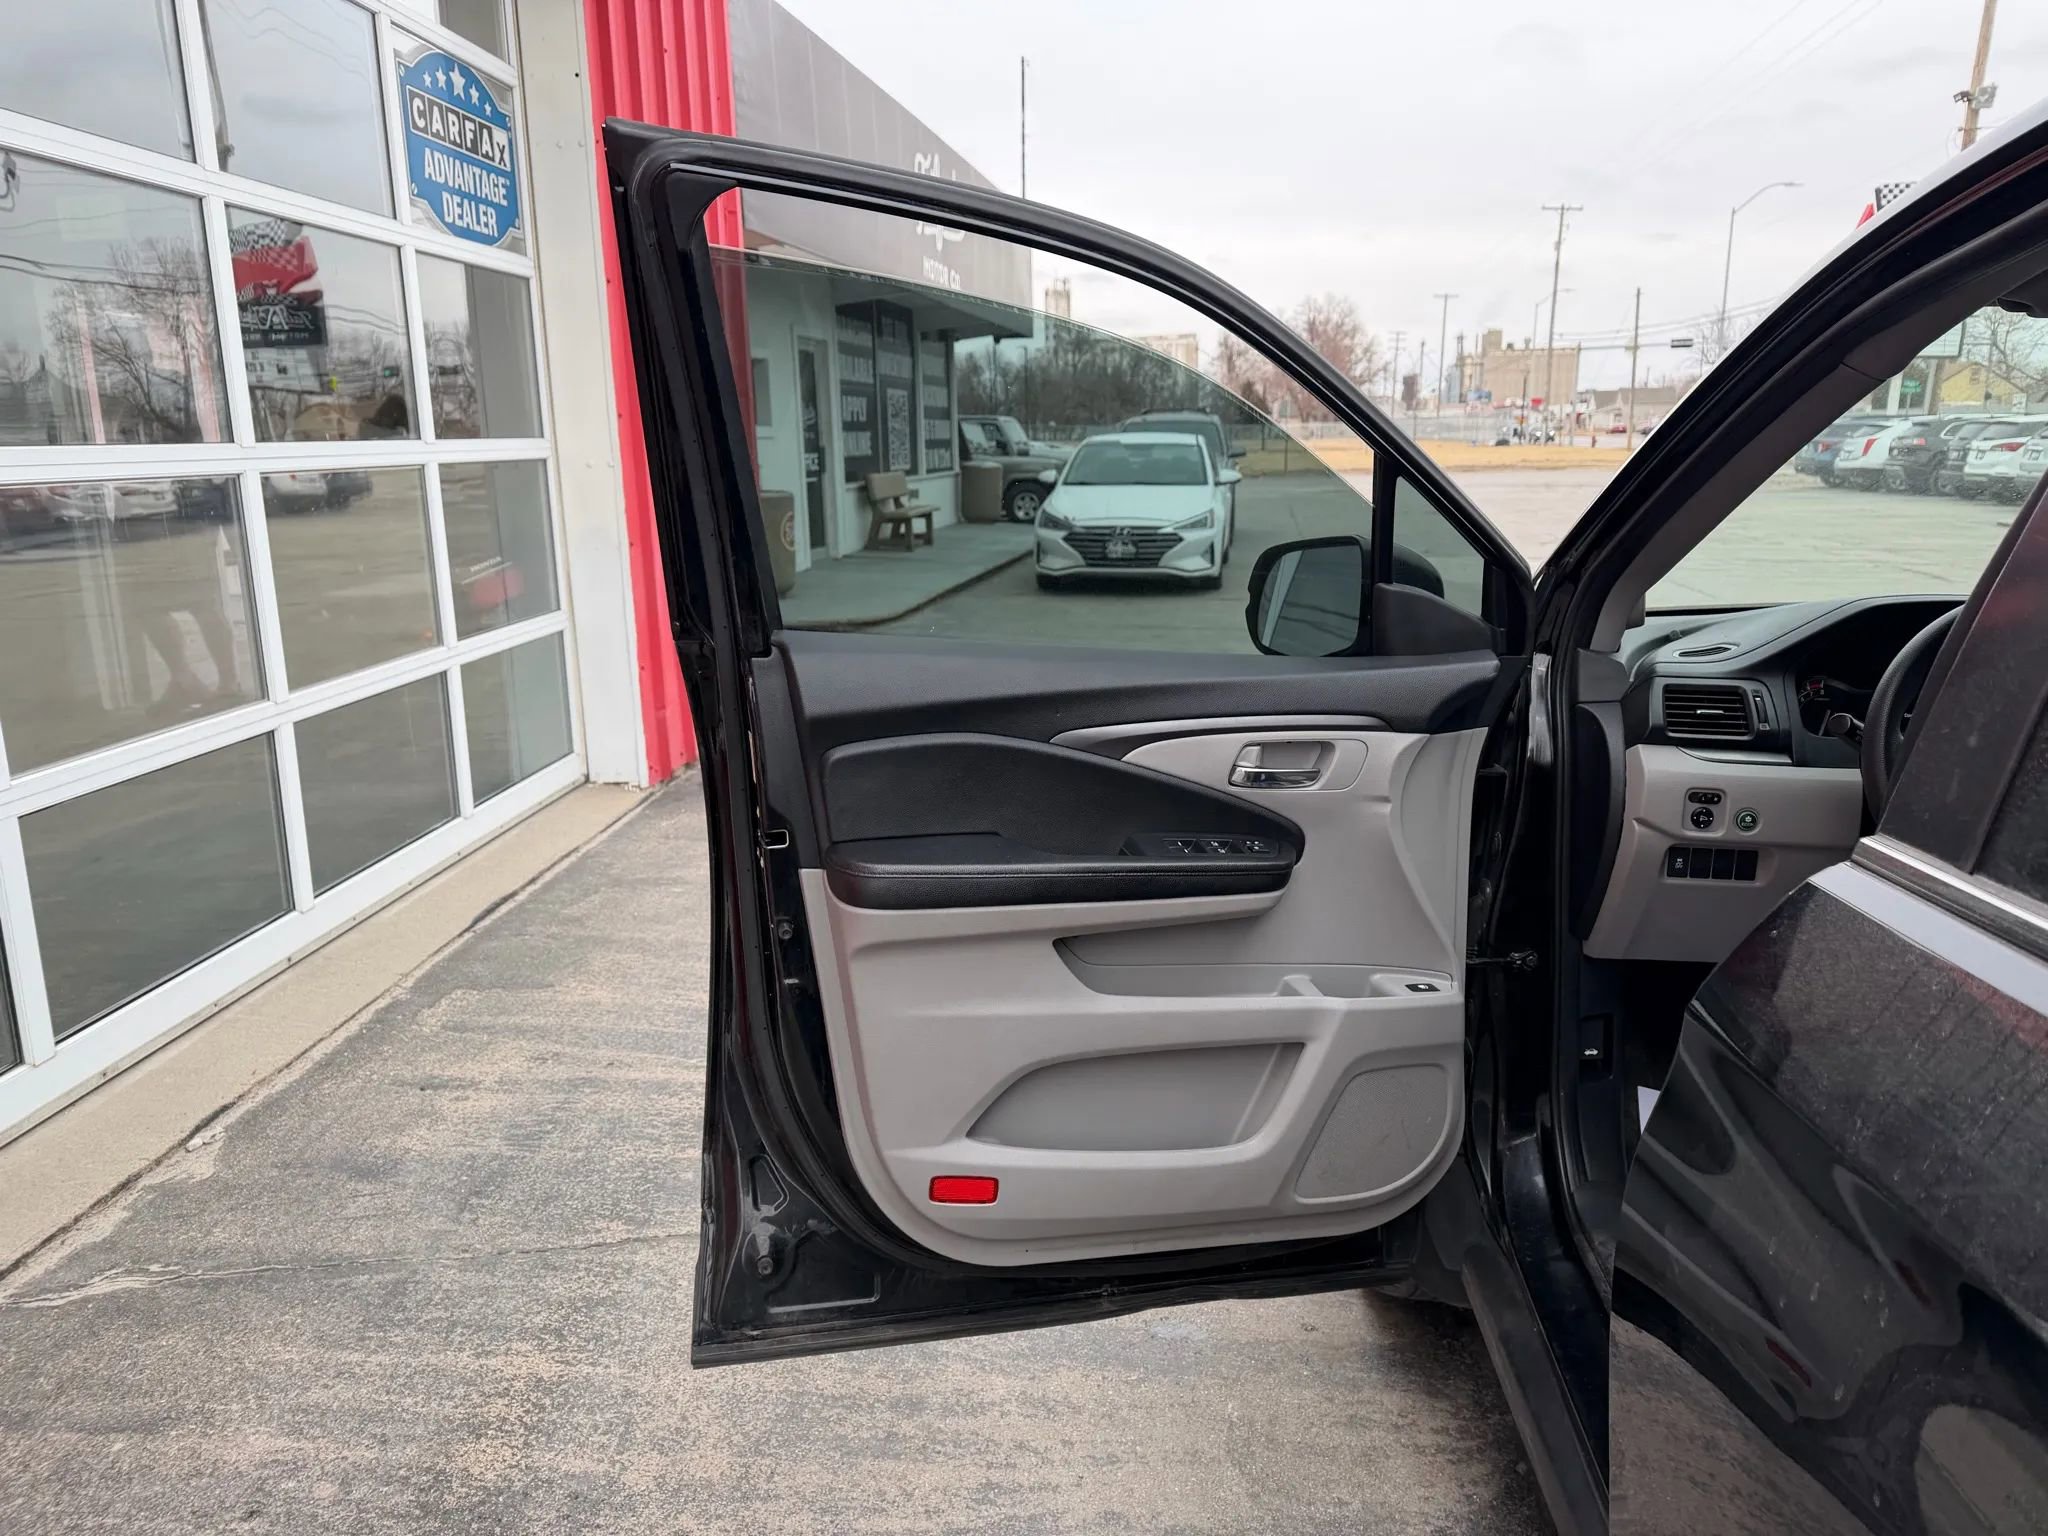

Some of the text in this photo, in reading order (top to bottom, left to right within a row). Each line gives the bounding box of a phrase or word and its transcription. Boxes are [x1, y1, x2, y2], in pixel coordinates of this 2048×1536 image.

[412, 97, 507, 168] CARFAX
[424, 147, 508, 207] ADVANTAGE
[442, 191, 498, 237] DEALER
